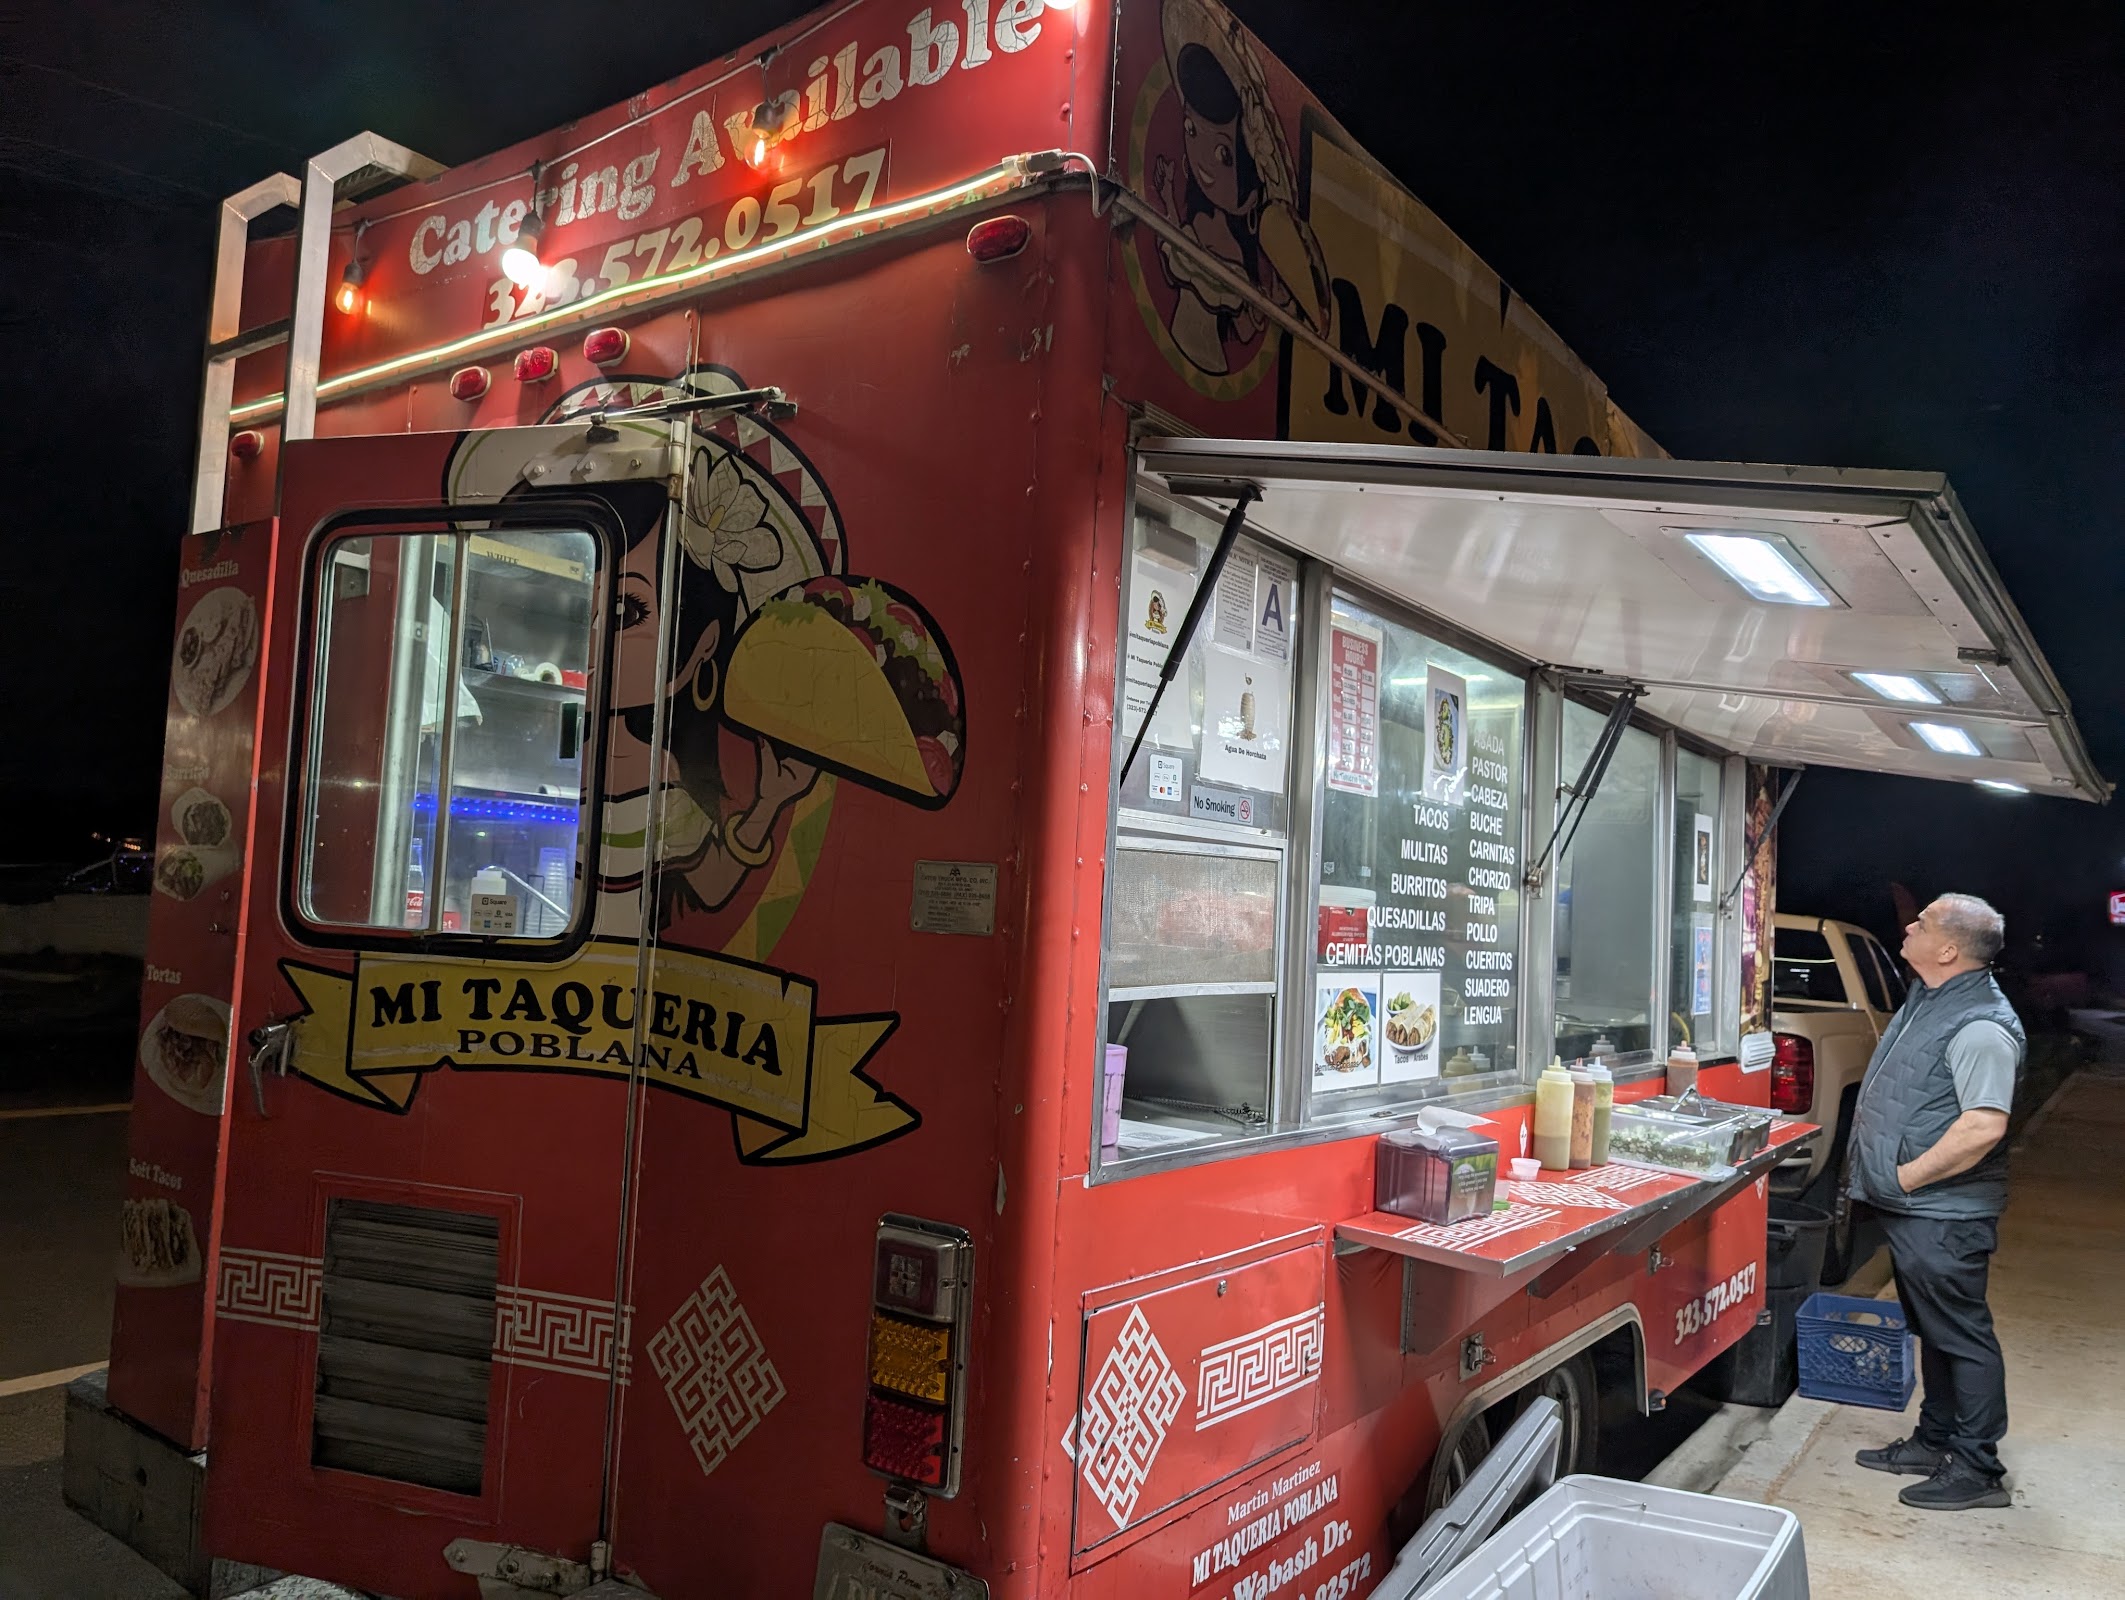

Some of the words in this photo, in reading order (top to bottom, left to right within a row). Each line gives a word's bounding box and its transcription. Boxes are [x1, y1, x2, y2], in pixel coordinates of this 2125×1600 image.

[1323, 277, 1447, 445] MI
[181, 559, 239, 588] Quesadilla
[1261, 583, 1284, 633] A
[1342, 635, 1368, 656] BUSINESS
[1225, 744, 1237, 754] Agua
[1238, 747, 1245, 756] De
[1246, 750, 1267, 761] Horchata
[1473, 731, 1505, 757] ASADA
[1472, 756, 1508, 784] PASTOR
[1194, 795, 1204, 809] No
[1205, 798, 1235, 818] Smoking
[1470, 783, 1509, 811] CABEZA
[1413, 804, 1449, 831] TACOS
[1470, 810, 1503, 836] BUCHE
[1401, 838, 1448, 866] MULITAS
[1469, 838, 1515, 865] CARNITAS
[1391, 873, 1447, 899] BURRITOS
[1468, 866, 1511, 891] CHORIZO
[490, 898, 507, 906] Square
[1467, 894, 1495, 916] TRIPA
[1366, 905, 1446, 931] QUESADILLAS
[1466, 922, 1498, 943] POLLO
[1325, 942, 1382, 966] CEMITAS
[1384, 945, 1446, 967] POBLANAS
[1465, 950, 1513, 971] CUERITOS
[147, 965, 181, 985] Tortas
[1465, 978, 1510, 998] SUADERO
[370, 981, 442, 1028] MI
[462, 978, 783, 1076] TAQUERIA
[1464, 1005, 1502, 1026] LENGUA
[457, 1029, 702, 1080] POBLANA
[1394, 1054, 1409, 1064] Tacos
[1414, 1053, 1429, 1062] Arabes
[152, 1163, 183, 1190] Tacos
[1675, 1261, 1757, 1345] 323.572.0517
[1227, 1488, 1269, 1525] Martin
[1271, 1459, 1321, 1501] Martinez
[1192, 1549, 1211, 1587] MI
[1213, 1508, 1281, 1573] TAQUERIA
[1283, 1474, 1338, 1532] POBLANA
[1233, 1535, 1318, 1600] Wabash
[1321, 1519, 1353, 1559] Dr.
